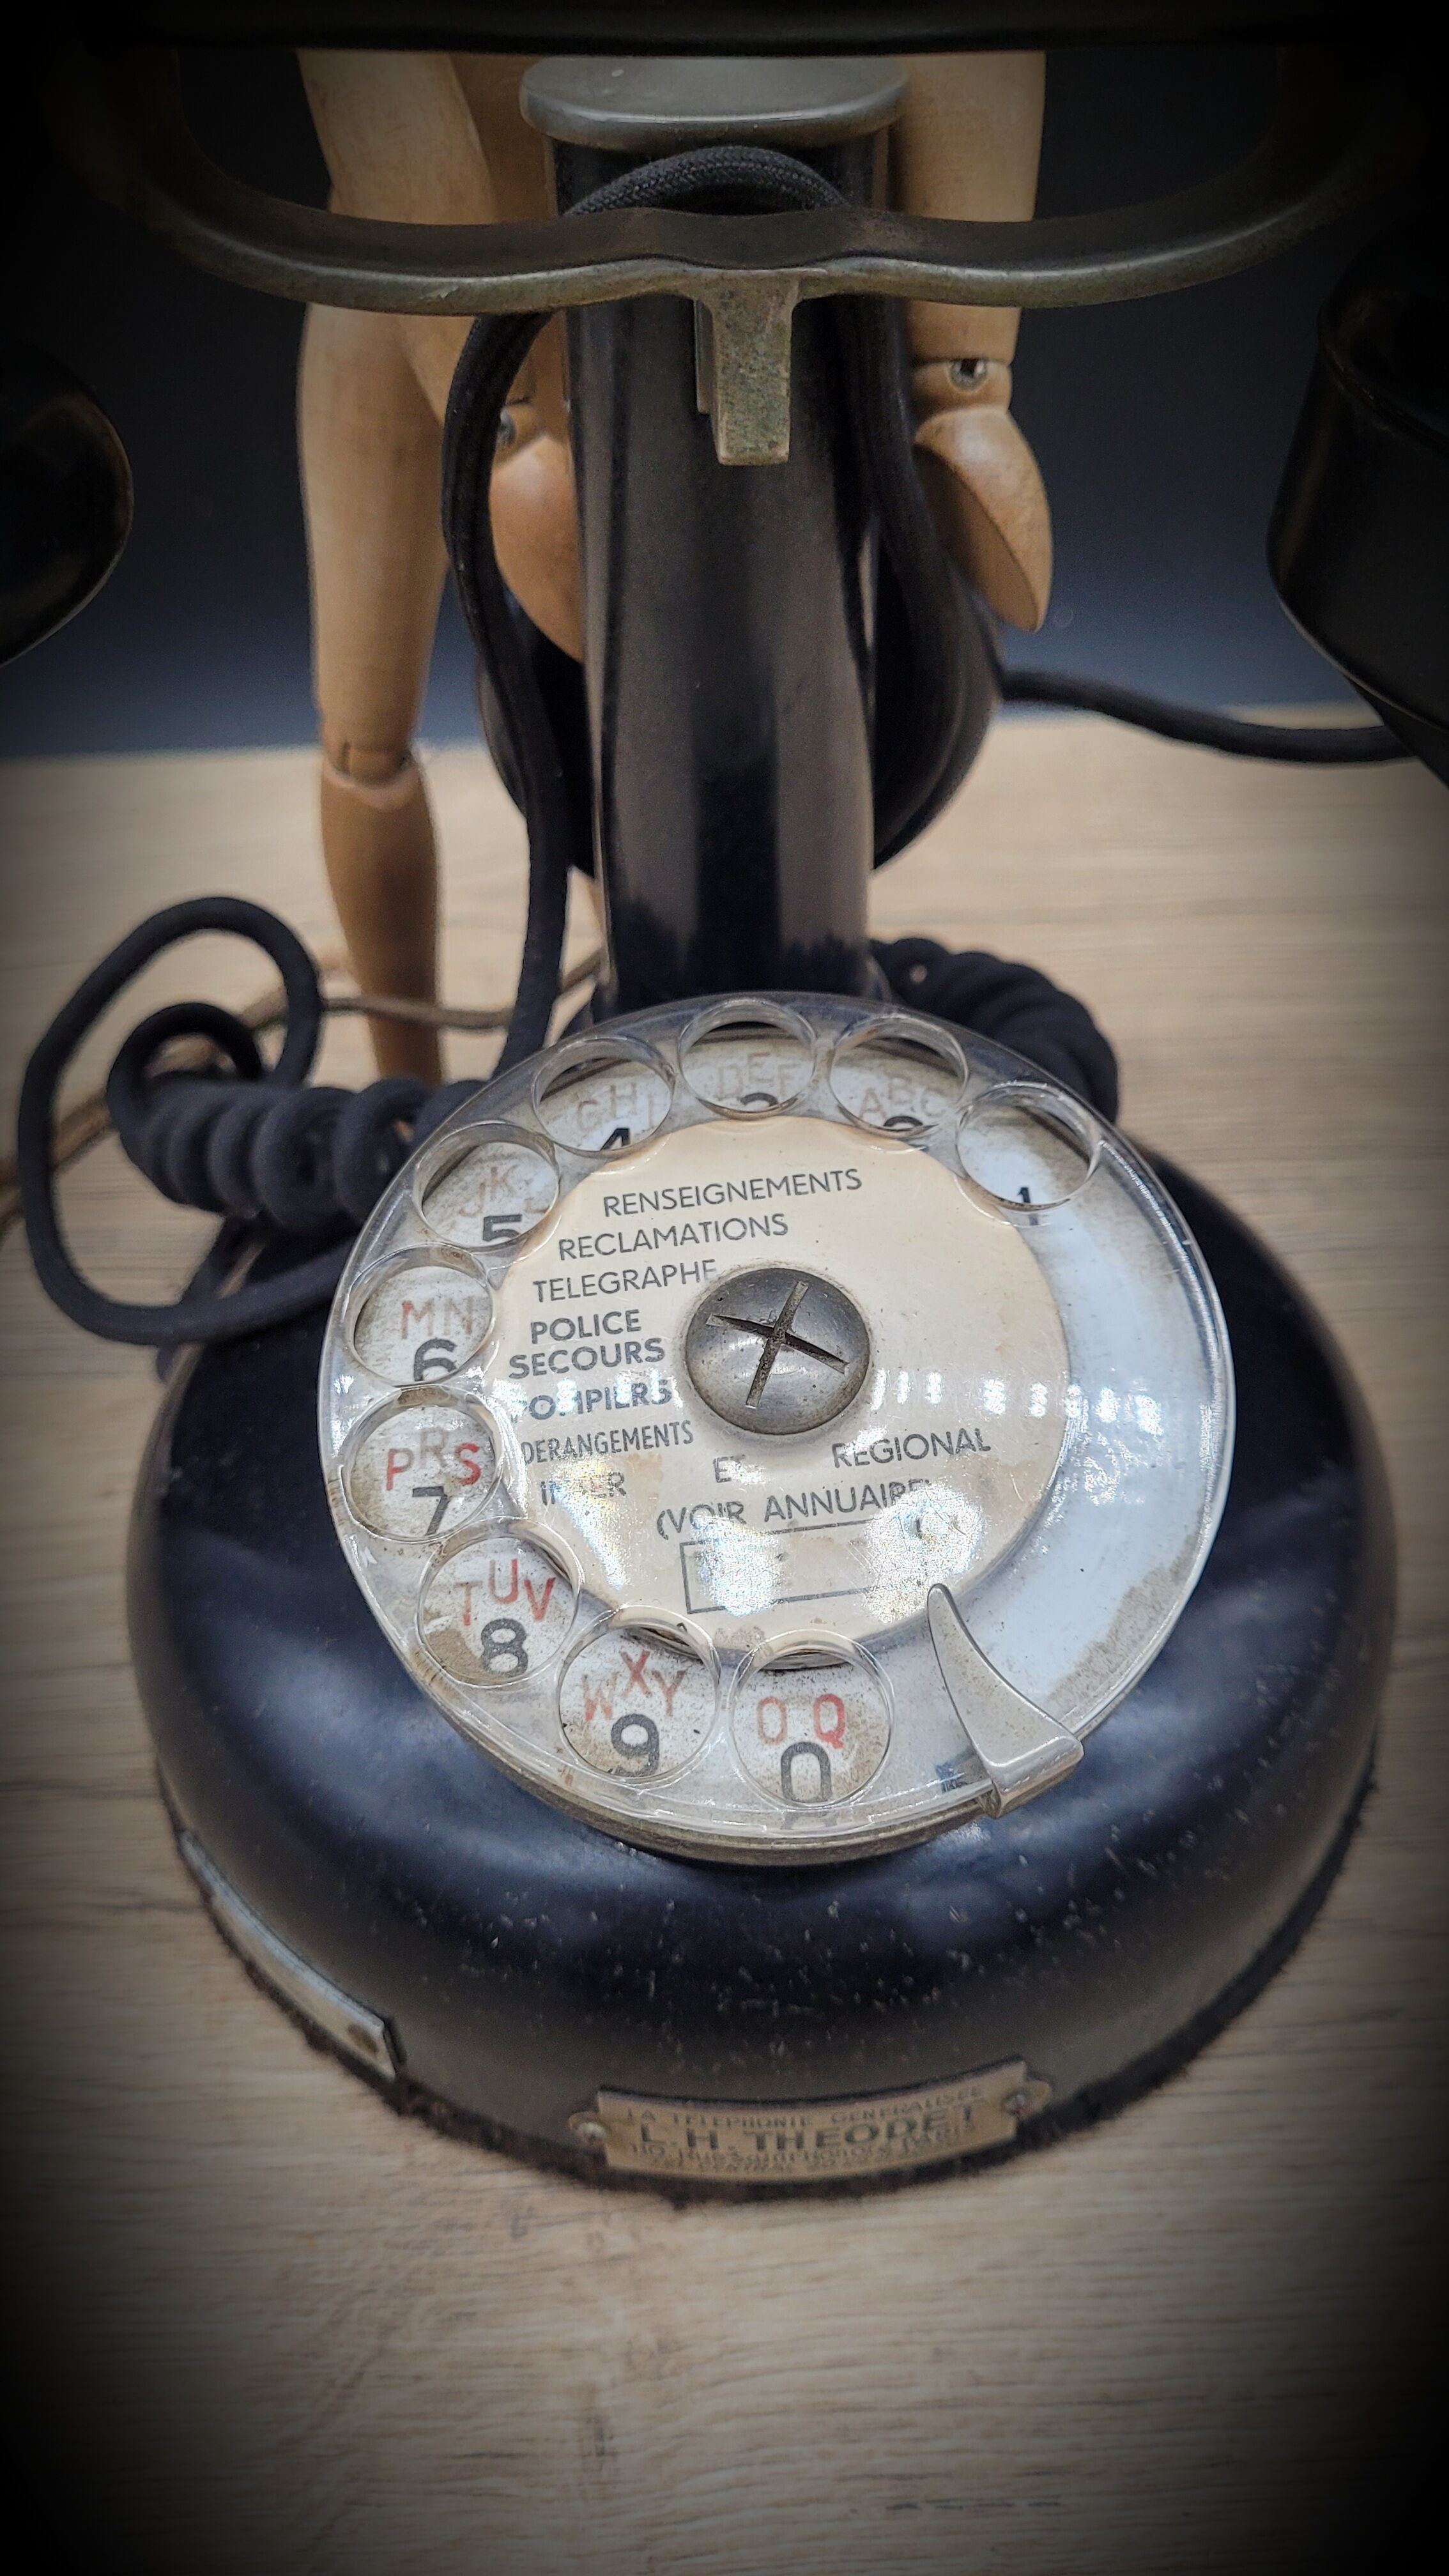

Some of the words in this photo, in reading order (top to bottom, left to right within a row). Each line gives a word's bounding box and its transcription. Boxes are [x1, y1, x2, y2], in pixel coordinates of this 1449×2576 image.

[604, 1169, 862, 1217] RENSEIGNEMENTS
[559, 1213, 788, 1260] RECLAMATIONS
[531, 1309, 641, 1344] POLICE
[414, 1338, 456, 1381] 6
[509, 1338, 664, 1379] SECOURS
[387, 1428, 481, 1490] PRS
[521, 1420, 694, 1465] DERANGEMENTS
[832, 1427, 991, 1468] REGIONAL
[412, 1486, 449, 1534] 7
[455, 1558, 555, 1625] TUV
[480, 1618, 528, 1676] 8
[584, 1650, 684, 1721] WXY
[611, 1713, 659, 1776] 9
